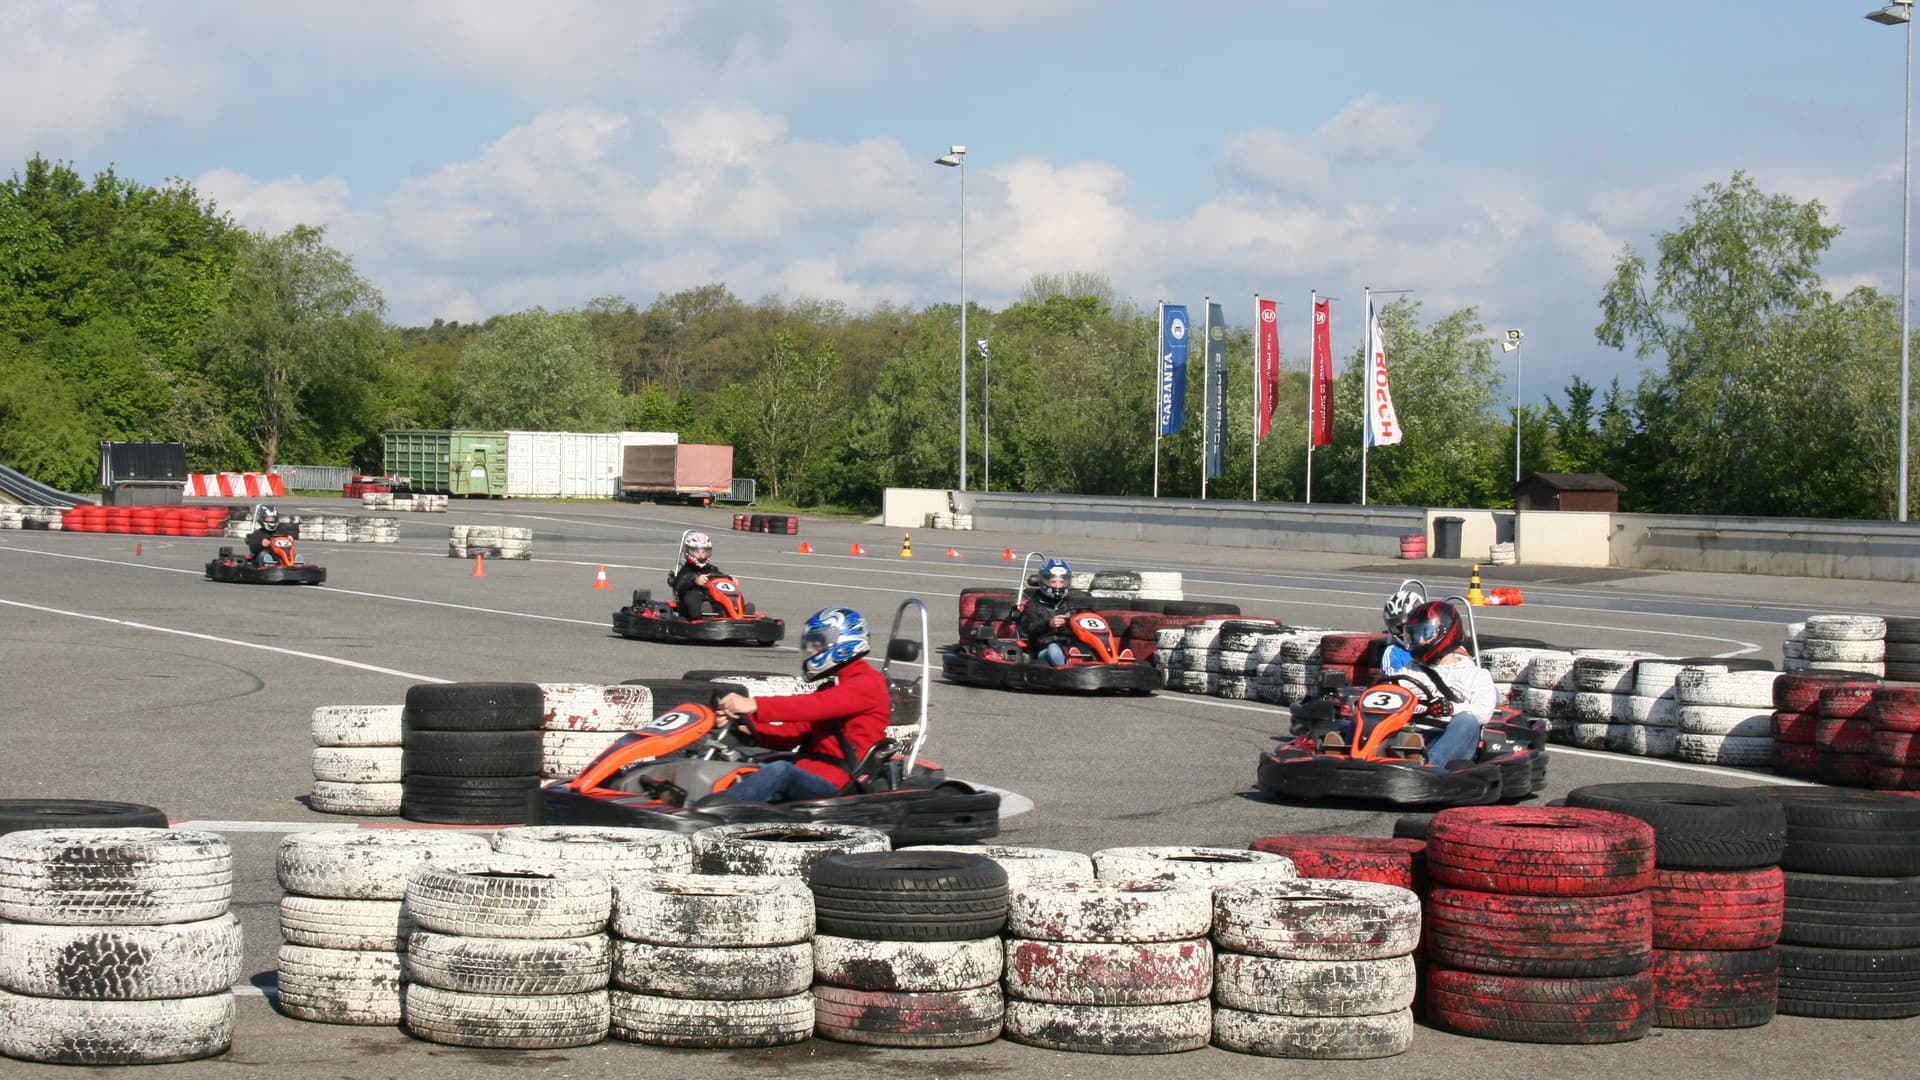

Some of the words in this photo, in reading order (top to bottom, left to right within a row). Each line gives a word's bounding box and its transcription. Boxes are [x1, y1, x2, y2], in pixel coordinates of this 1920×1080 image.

[1163, 352, 1174, 425] GARANTA
[1375, 352, 1393, 437] BOSCH
[1087, 619, 1099, 628] 8
[1373, 694, 1391, 706] 3
[656, 714, 679, 726] 9
